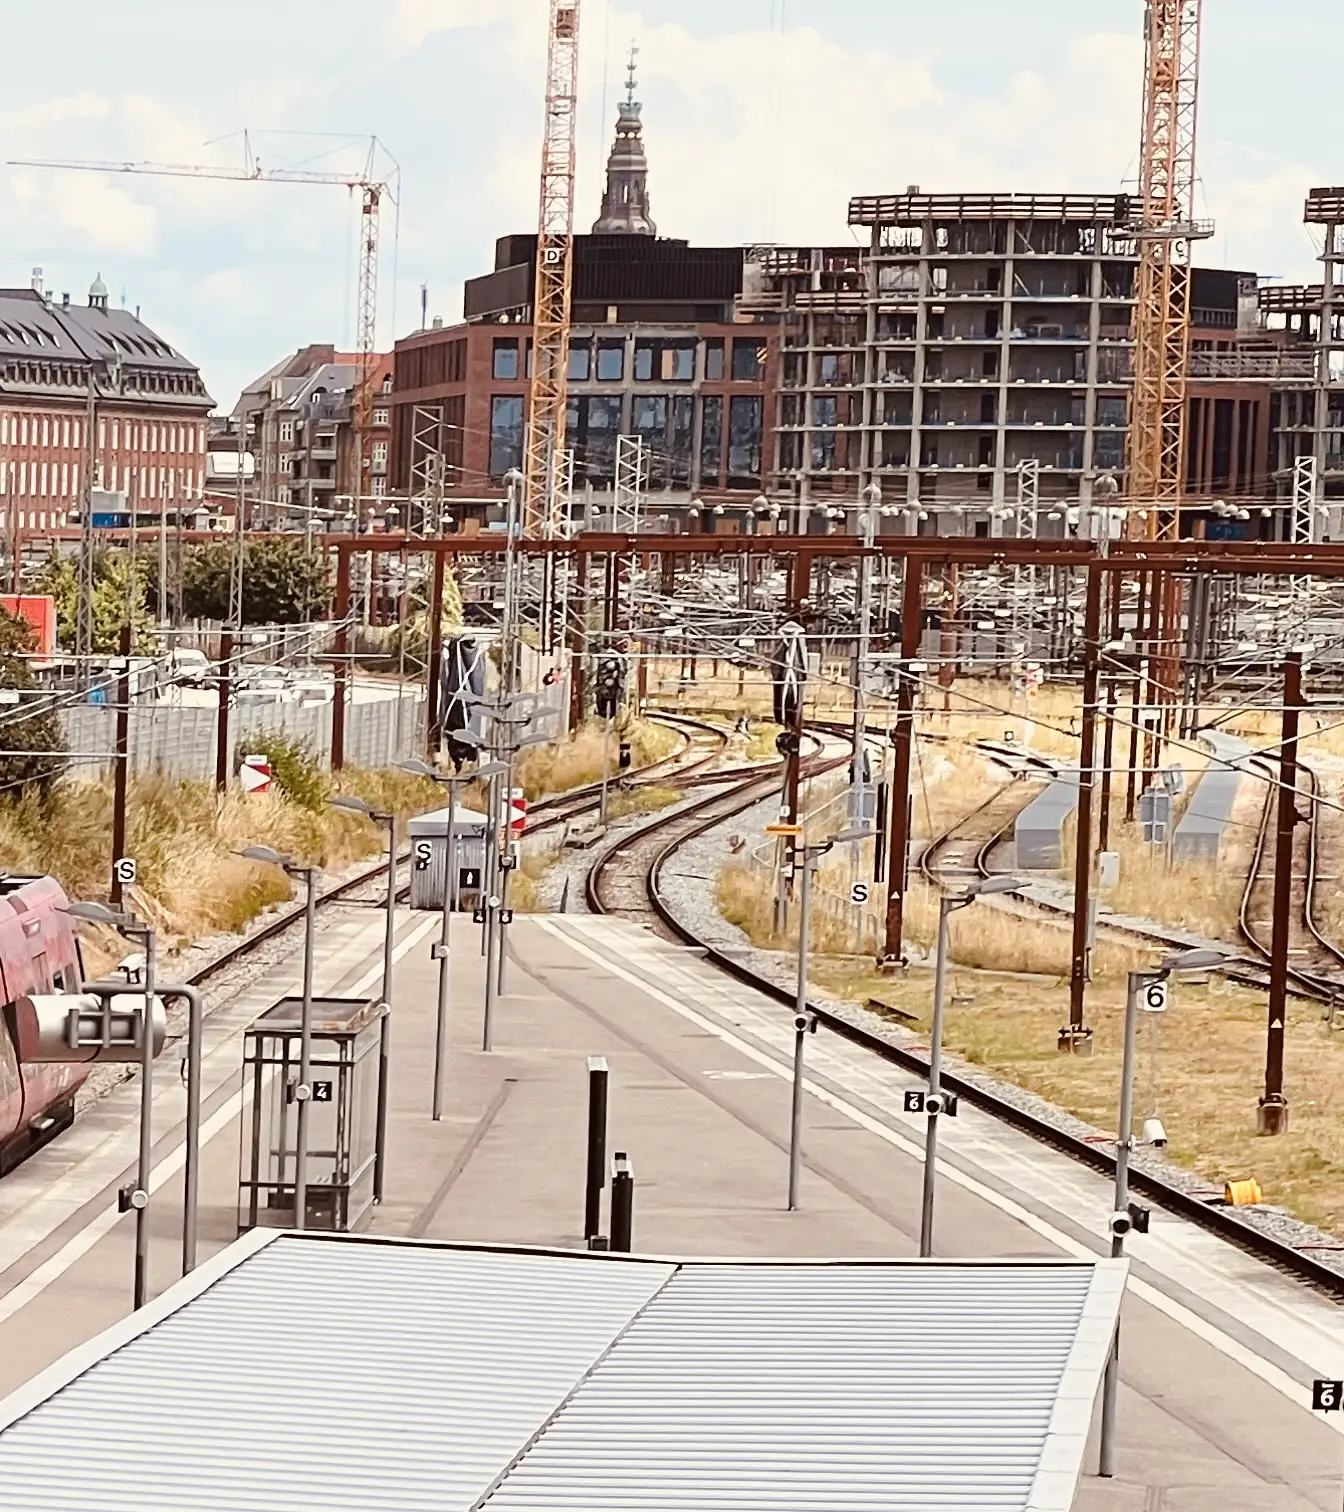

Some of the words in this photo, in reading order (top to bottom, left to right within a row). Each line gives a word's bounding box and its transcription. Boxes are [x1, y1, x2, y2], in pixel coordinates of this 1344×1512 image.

[547, 250, 557, 261] D
[120, 861, 134, 879] S
[852, 884, 868, 902] S
[1147, 985, 1164, 1008] 6
[317, 1087, 327, 1099] 4
[909, 1097, 919, 1110] 6
[1320, 1388, 1335, 1407] 6
